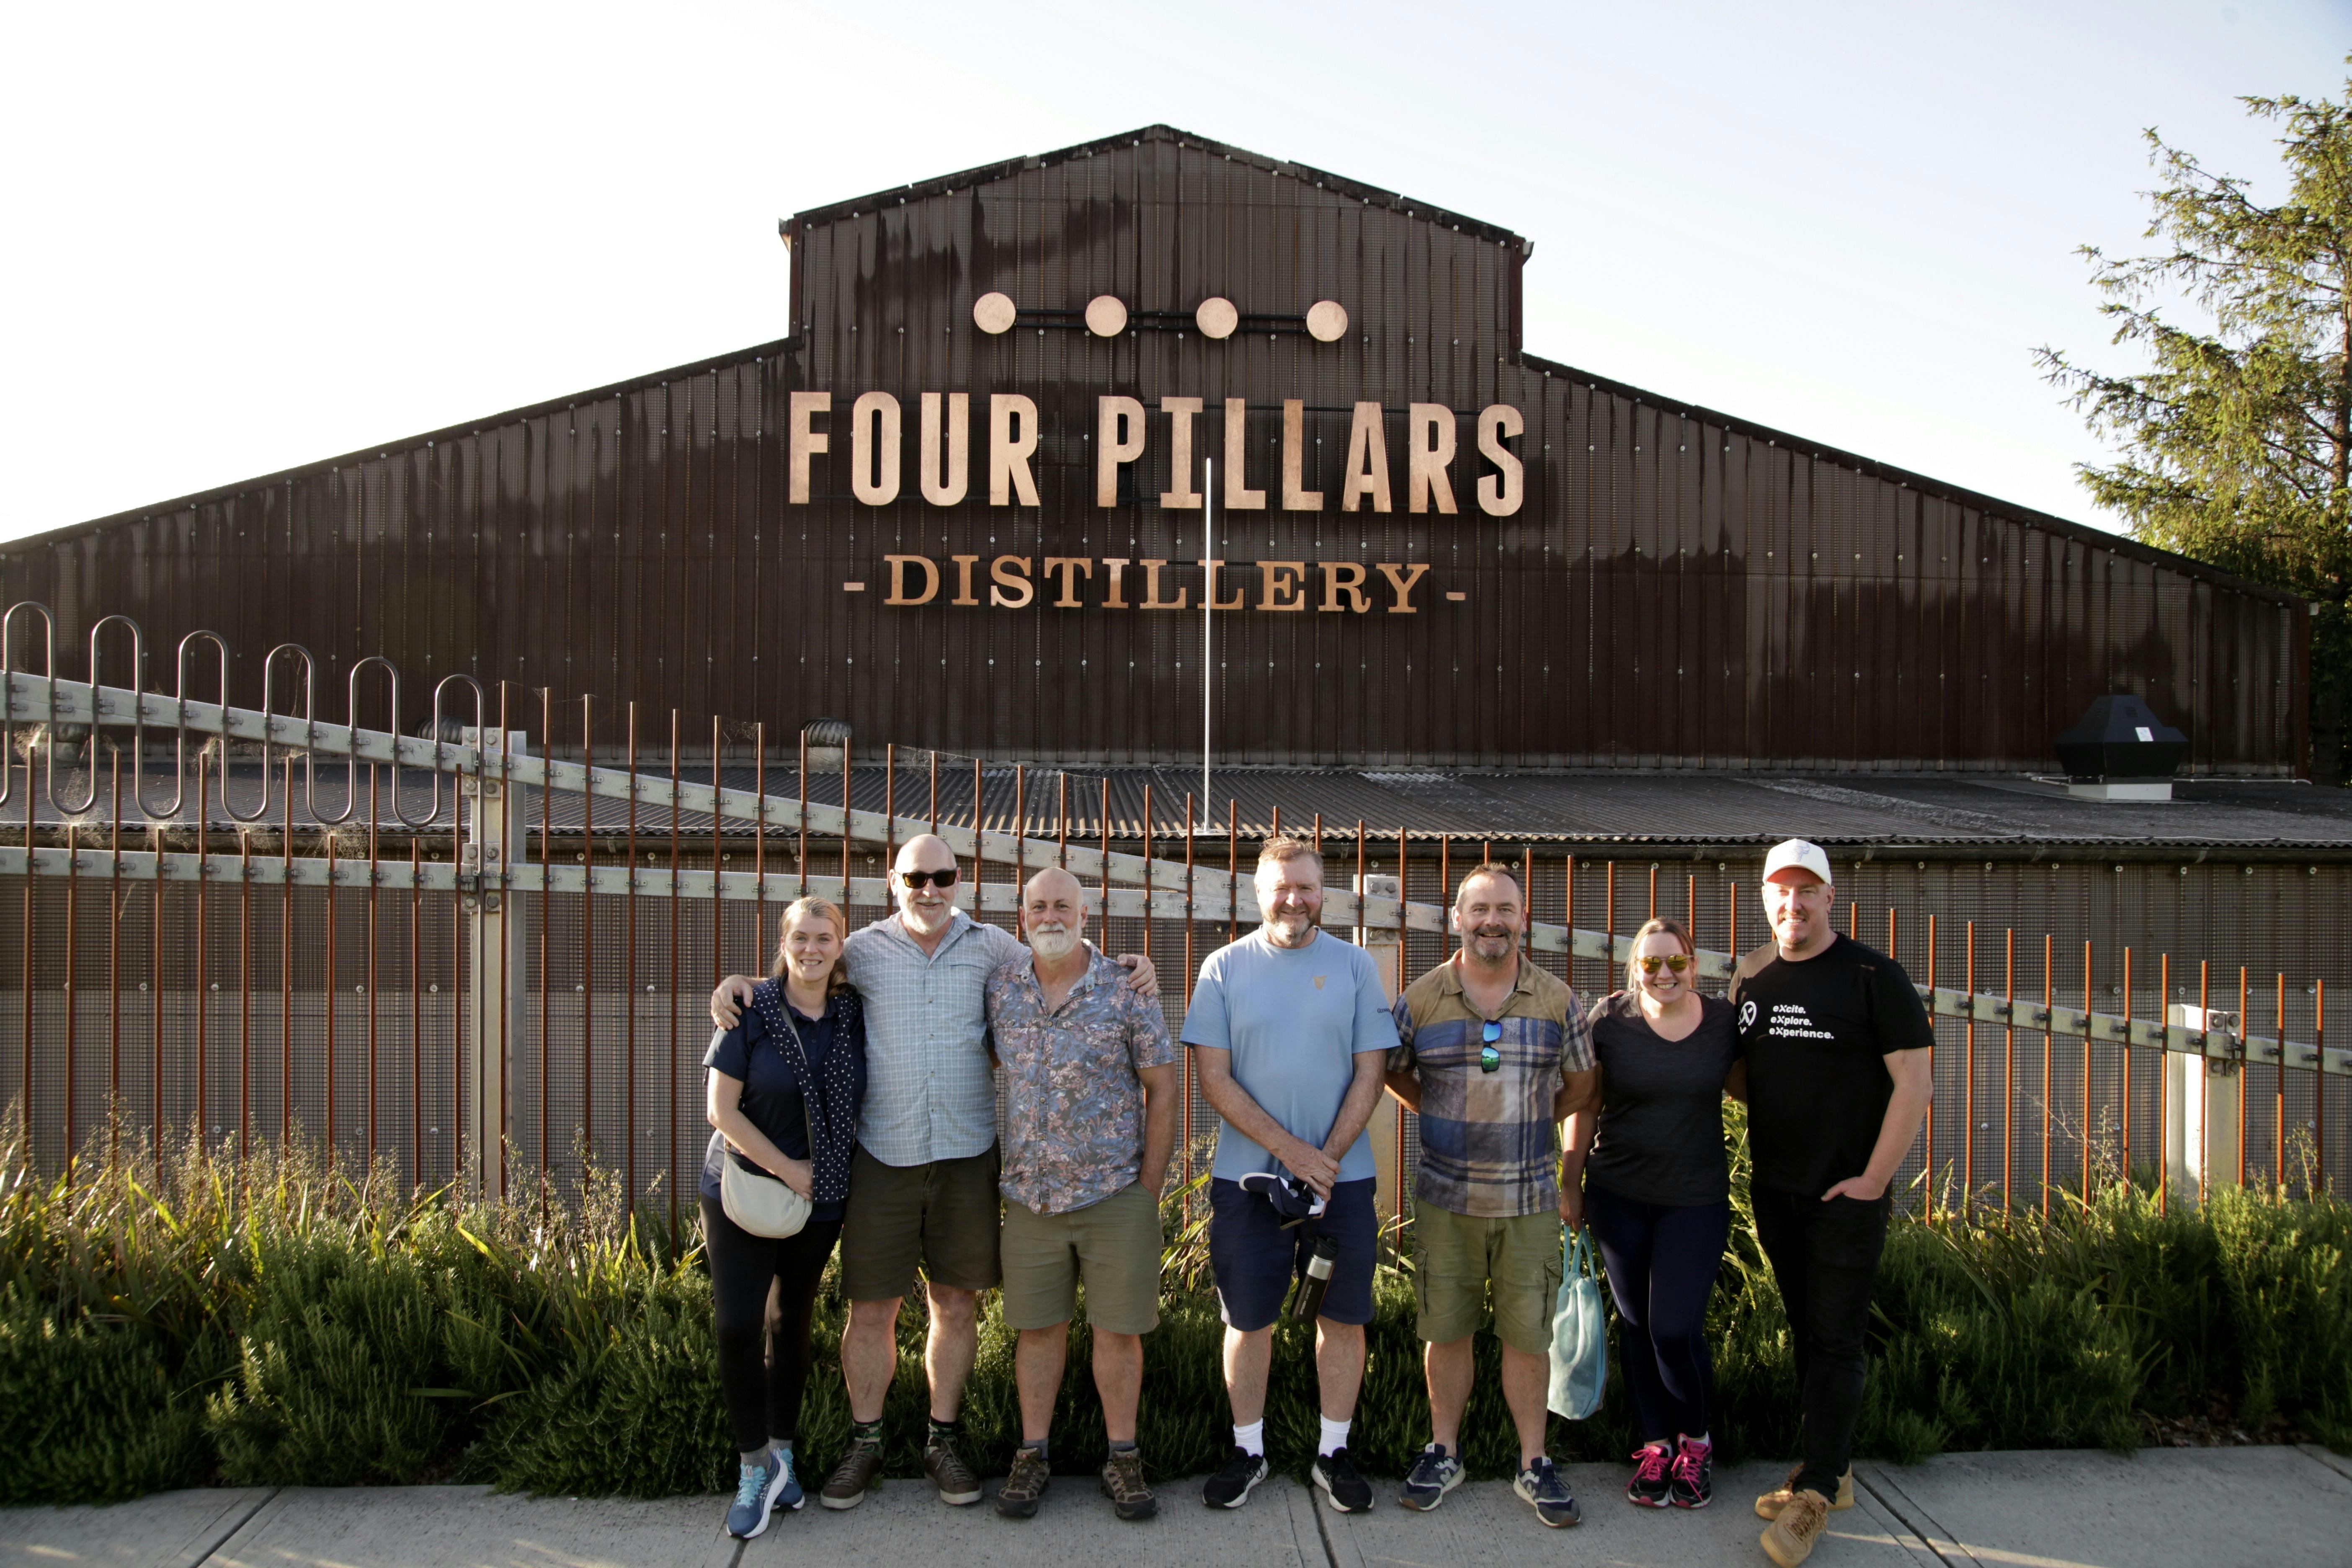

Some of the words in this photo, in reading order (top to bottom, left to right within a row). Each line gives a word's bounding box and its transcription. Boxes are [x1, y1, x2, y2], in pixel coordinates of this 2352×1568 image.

[789, 391, 1040, 506] FOUR
[1098, 396, 1524, 517] PILLARS
[884, 554, 1430, 614] DISTILLERY
[1773, 1004, 1806, 1014] eXcite.
[1770, 1015, 1812, 1026] eXplore.
[1769, 1026, 1834, 1039] eXperience.
